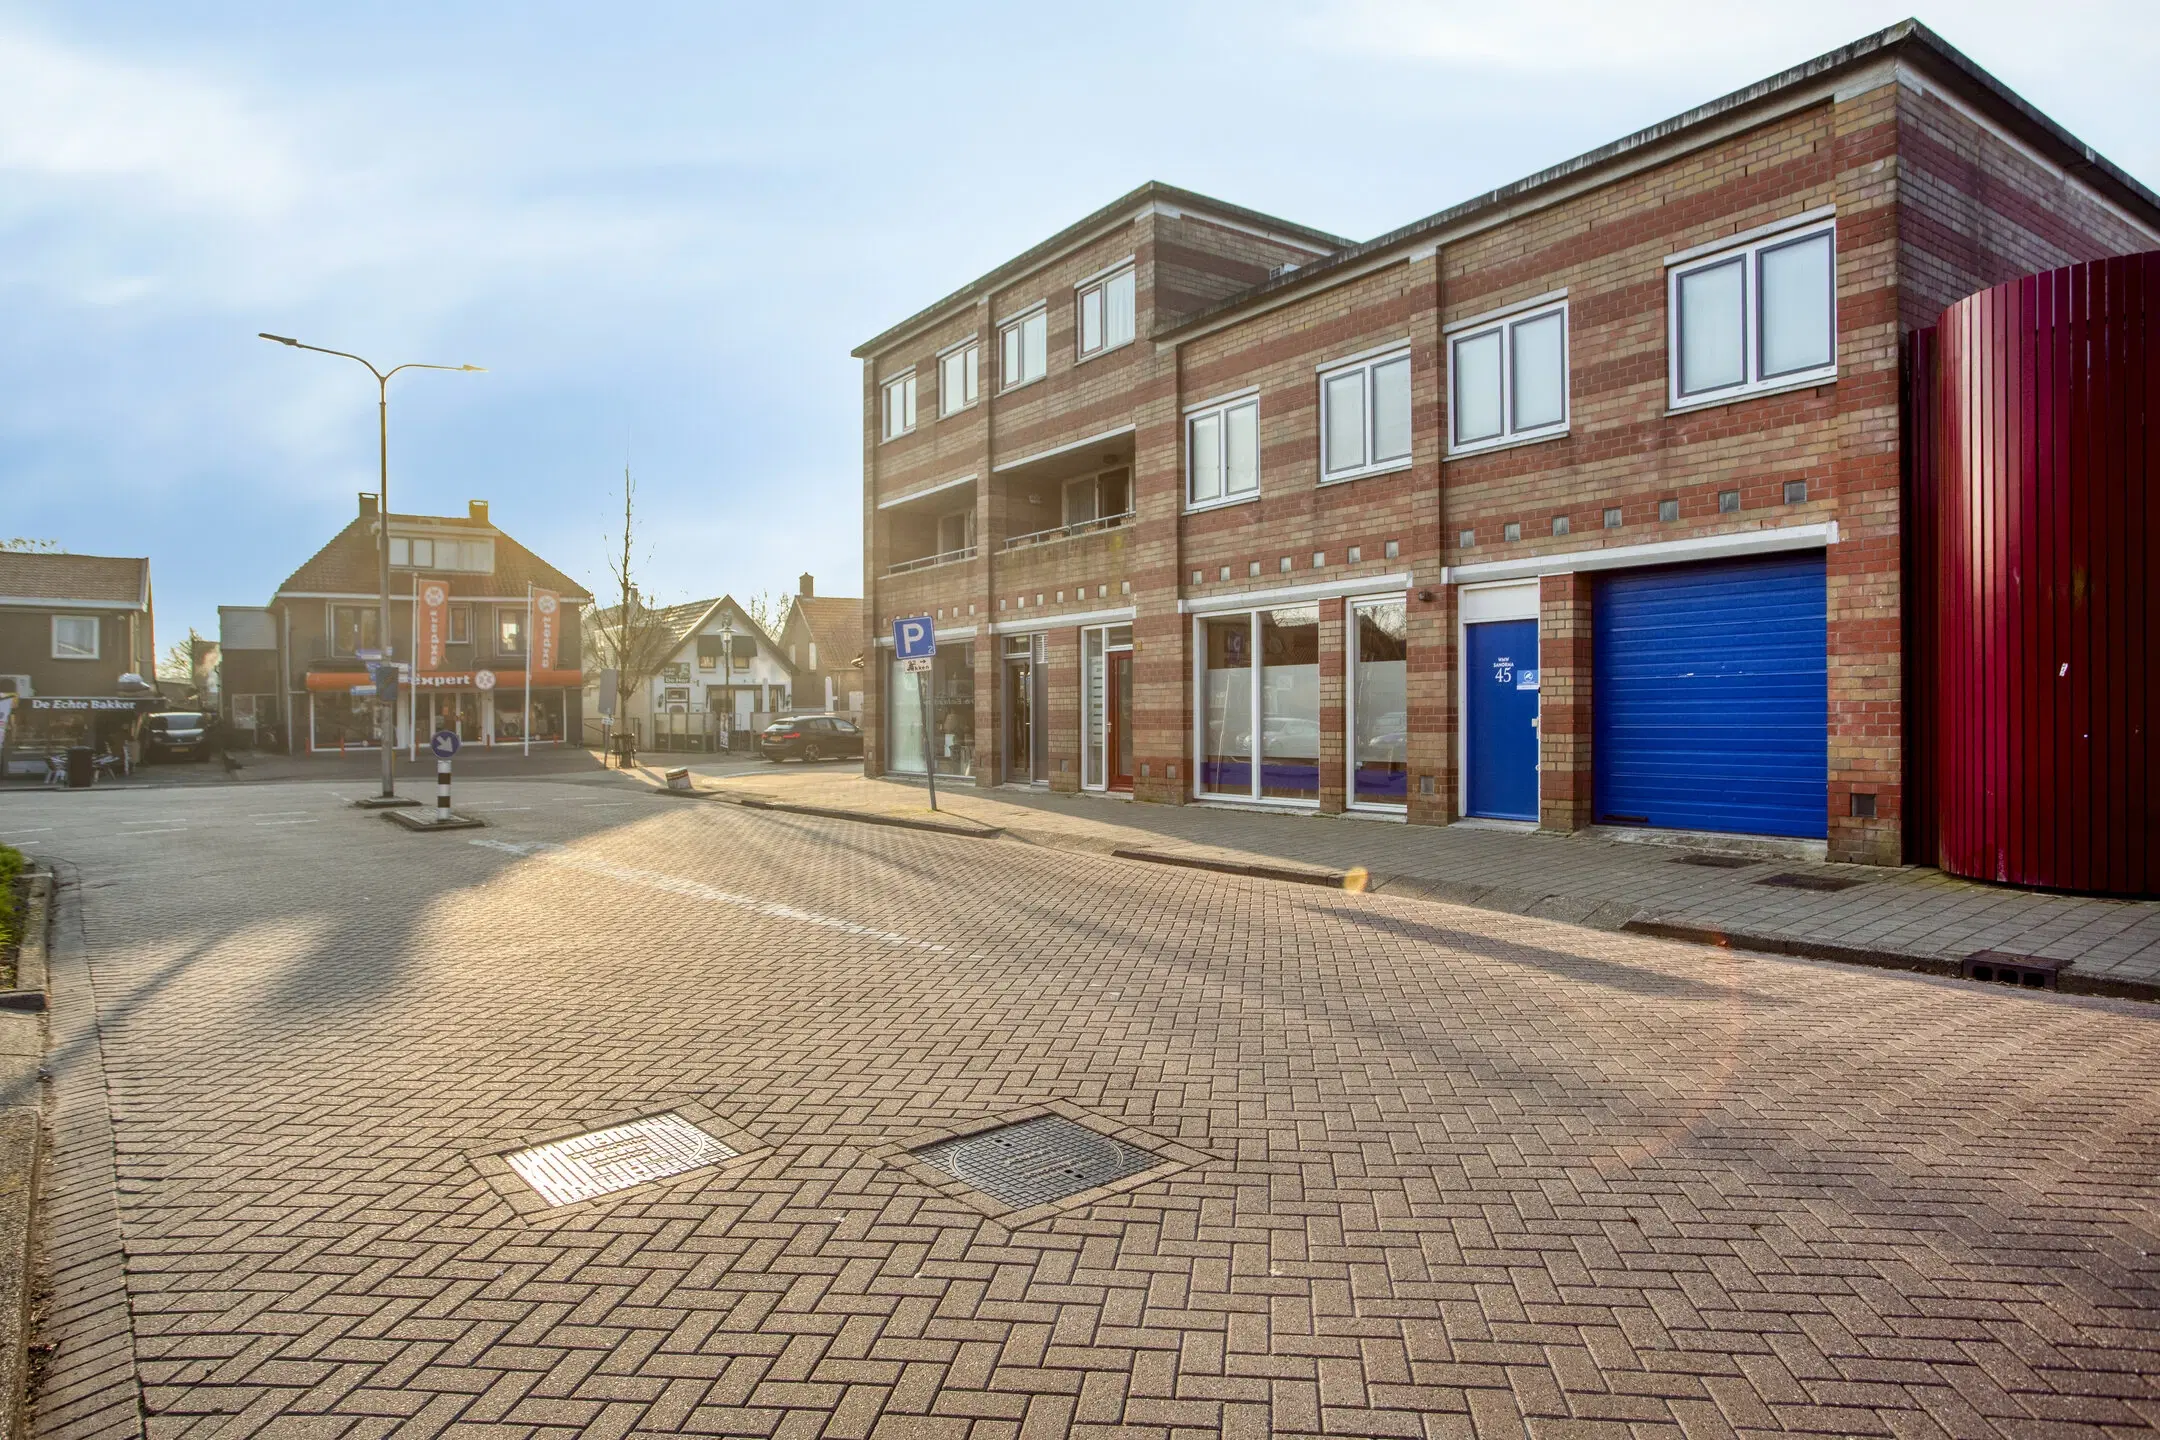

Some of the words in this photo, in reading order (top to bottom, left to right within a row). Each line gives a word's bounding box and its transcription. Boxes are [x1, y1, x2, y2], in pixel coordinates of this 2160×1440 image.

[902, 623, 924, 654] P
[414, 674, 470, 687] expert
[1495, 667, 1512, 683] 45
[32, 699, 50, 709] De
[52, 699, 89, 709] Echte
[90, 699, 136, 709] Bakker
